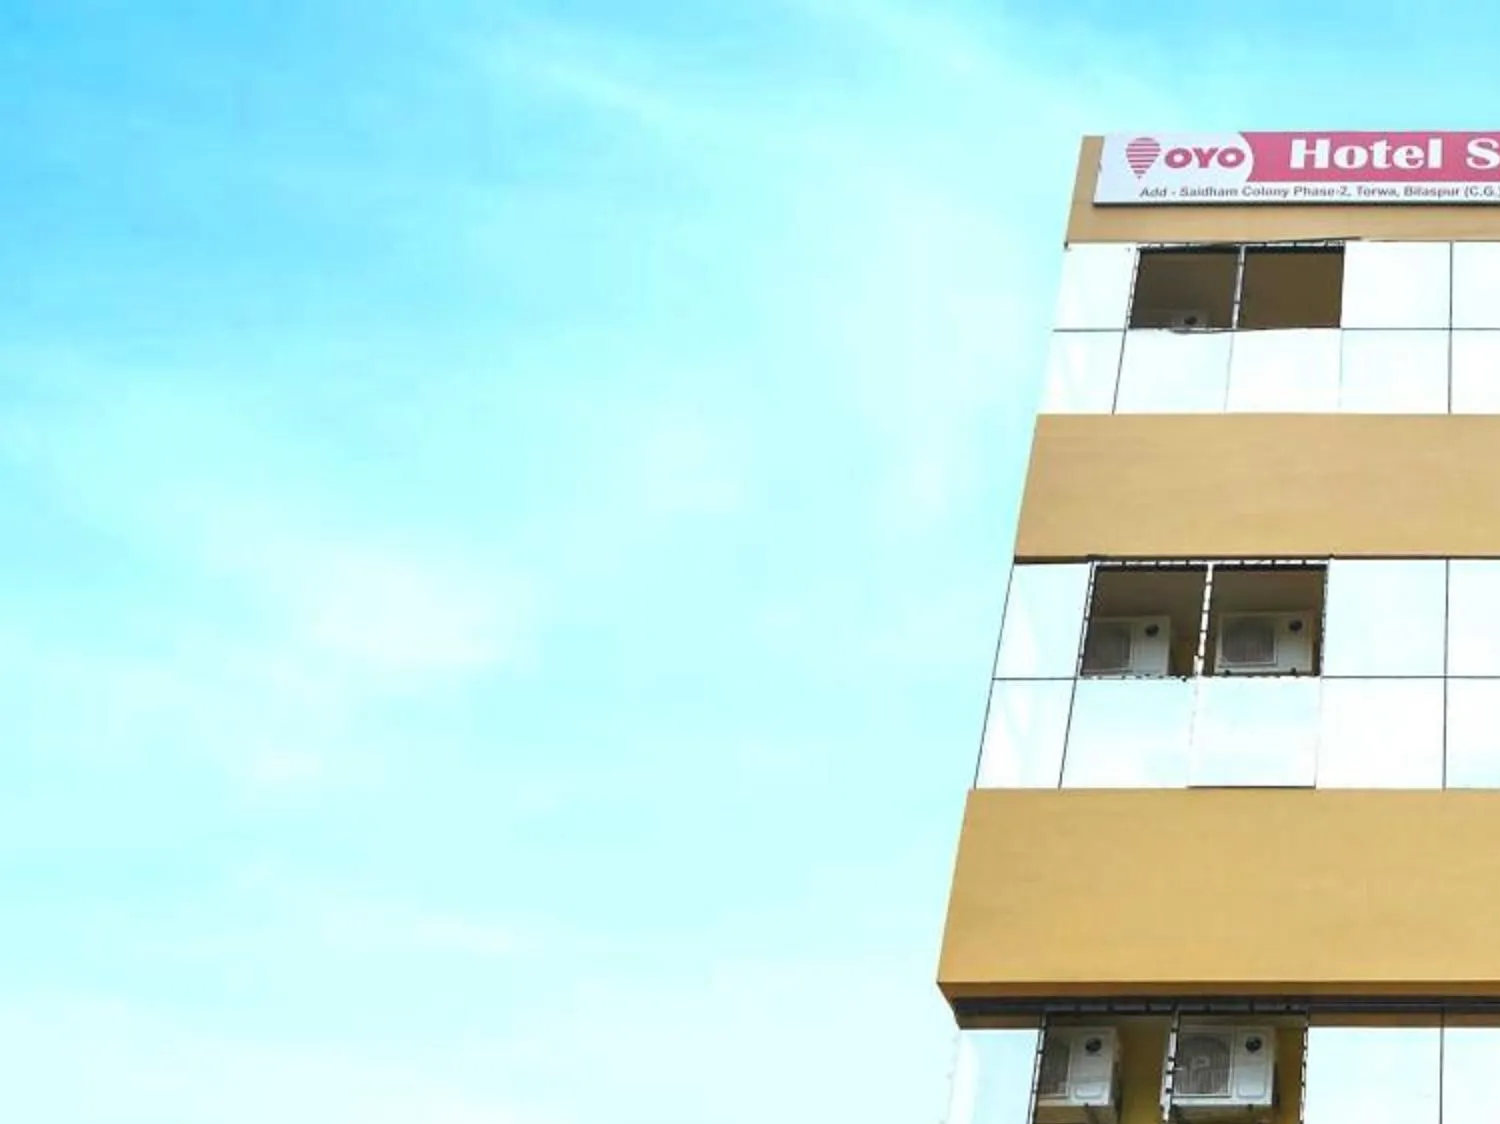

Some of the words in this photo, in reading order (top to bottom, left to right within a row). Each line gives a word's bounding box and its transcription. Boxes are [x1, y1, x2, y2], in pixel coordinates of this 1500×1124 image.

[1164, 147, 1245, 169] OYO
[1289, 138, 1443, 170] Hotel
[1139, 186, 1167, 198] Add
[1179, 185, 1238, 197] Saidham
[1241, 186, 1289, 198] Colony
[1403, 185, 1460, 198] Bilaspur
